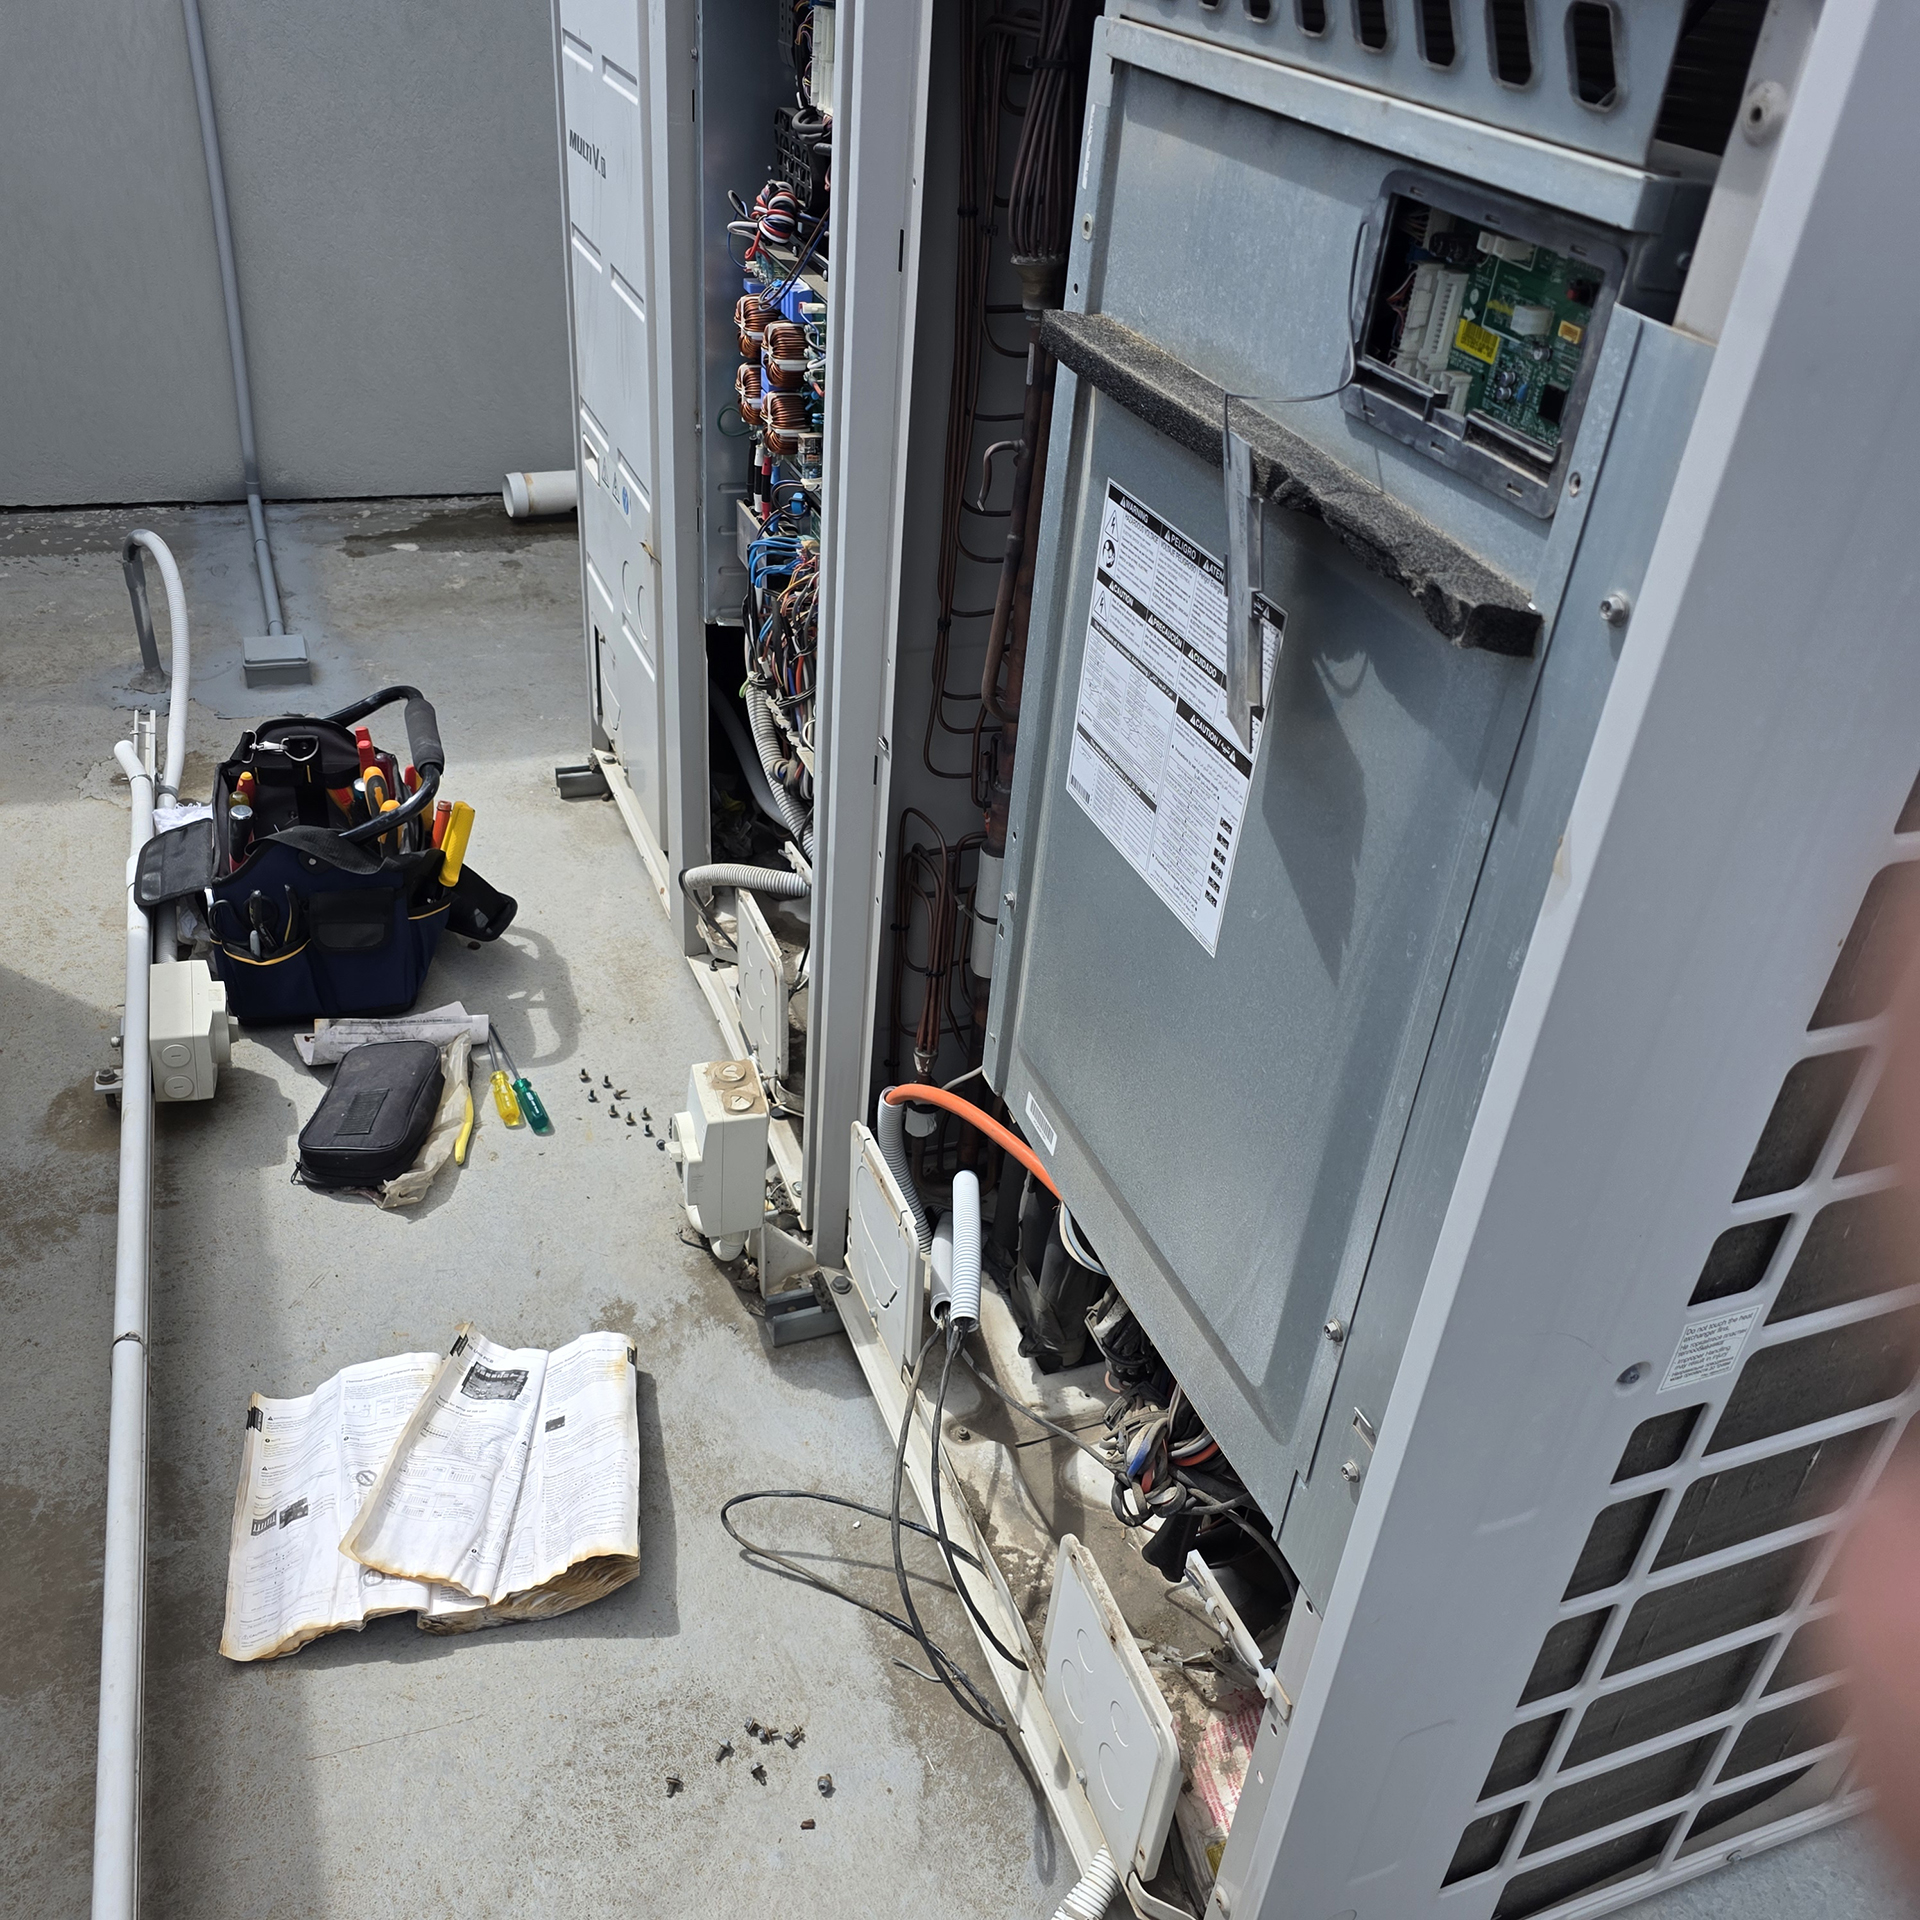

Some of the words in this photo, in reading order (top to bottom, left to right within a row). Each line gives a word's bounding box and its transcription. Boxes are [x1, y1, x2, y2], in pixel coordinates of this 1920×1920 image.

[569, 129, 592, 165] MULTI
[1124, 498, 1149, 525] WARNING
[1170, 532, 1197, 561] PELIGRO
[1207, 561, 1224, 583] ATEN
[1113, 582, 1134, 608] CAUTION
[1152, 614, 1183, 650] PRECAUCIÓN
[1192, 650, 1217, 680] CUIDADO
[1194, 715, 1219, 746] CAUTION
